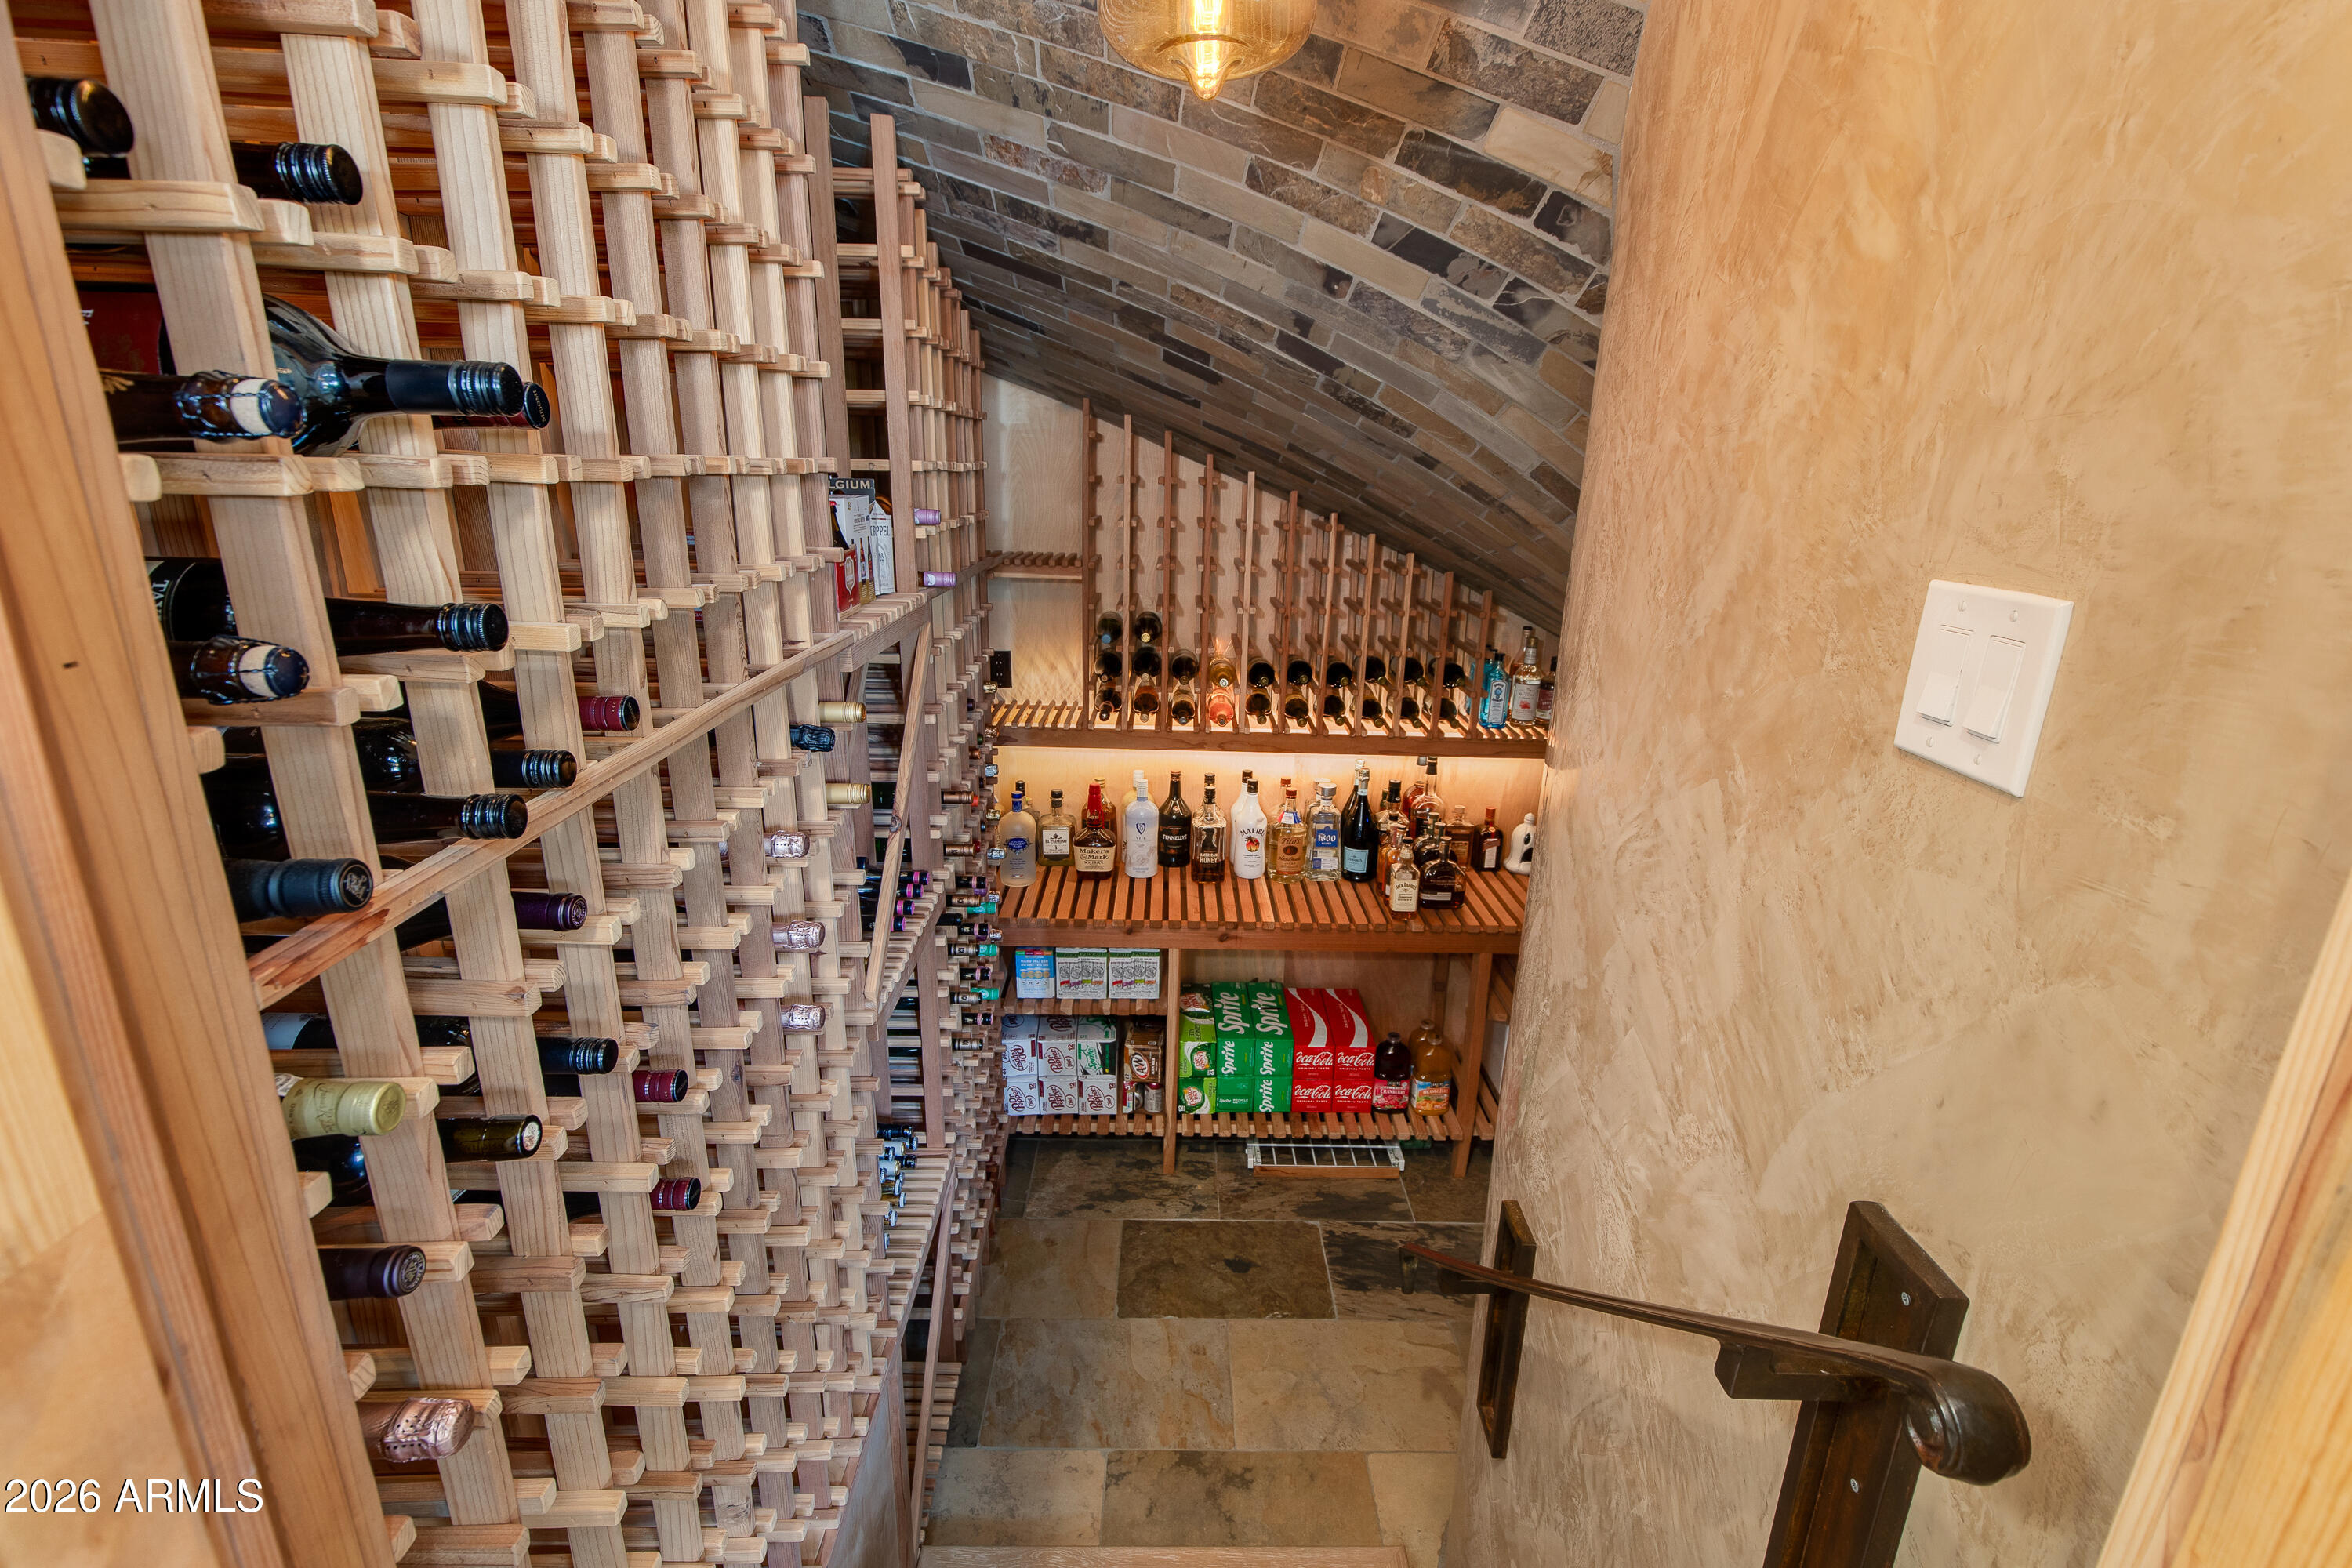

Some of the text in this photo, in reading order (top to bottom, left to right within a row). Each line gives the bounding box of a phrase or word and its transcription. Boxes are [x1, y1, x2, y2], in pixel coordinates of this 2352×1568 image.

[534, 390, 546, 423] MEIOMI
[828, 480, 873, 489] LGIUM.
[1240, 828, 1265, 837] MALIBU
[1214, 992, 1250, 1034] Sprite
[1251, 992, 1288, 1035] Sprite
[1011, 1047, 1025, 1069] Pepper
[1020, 1054, 1027, 1063] Dr
[1047, 1054, 1054, 1064] Dr
[1050, 1049, 1063, 1071] Pepper
[1088, 1047, 1098, 1069] Sprite
[1197, 1051, 1206, 1071] CANADA
[1221, 1041, 1237, 1074] Sprite
[1260, 1041, 1276, 1075] Sprite
[1009, 1094, 1014, 1103] Dr
[1011, 1088, 1025, 1109] Pepper
[1048, 1093, 1054, 1102] Dr
[1051, 1087, 1065, 1109] Pepper
[1087, 1093, 1094, 1102] Dr
[1089, 1088, 1104, 1109] Pepper
[1259, 1079, 1275, 1112] Sprite
